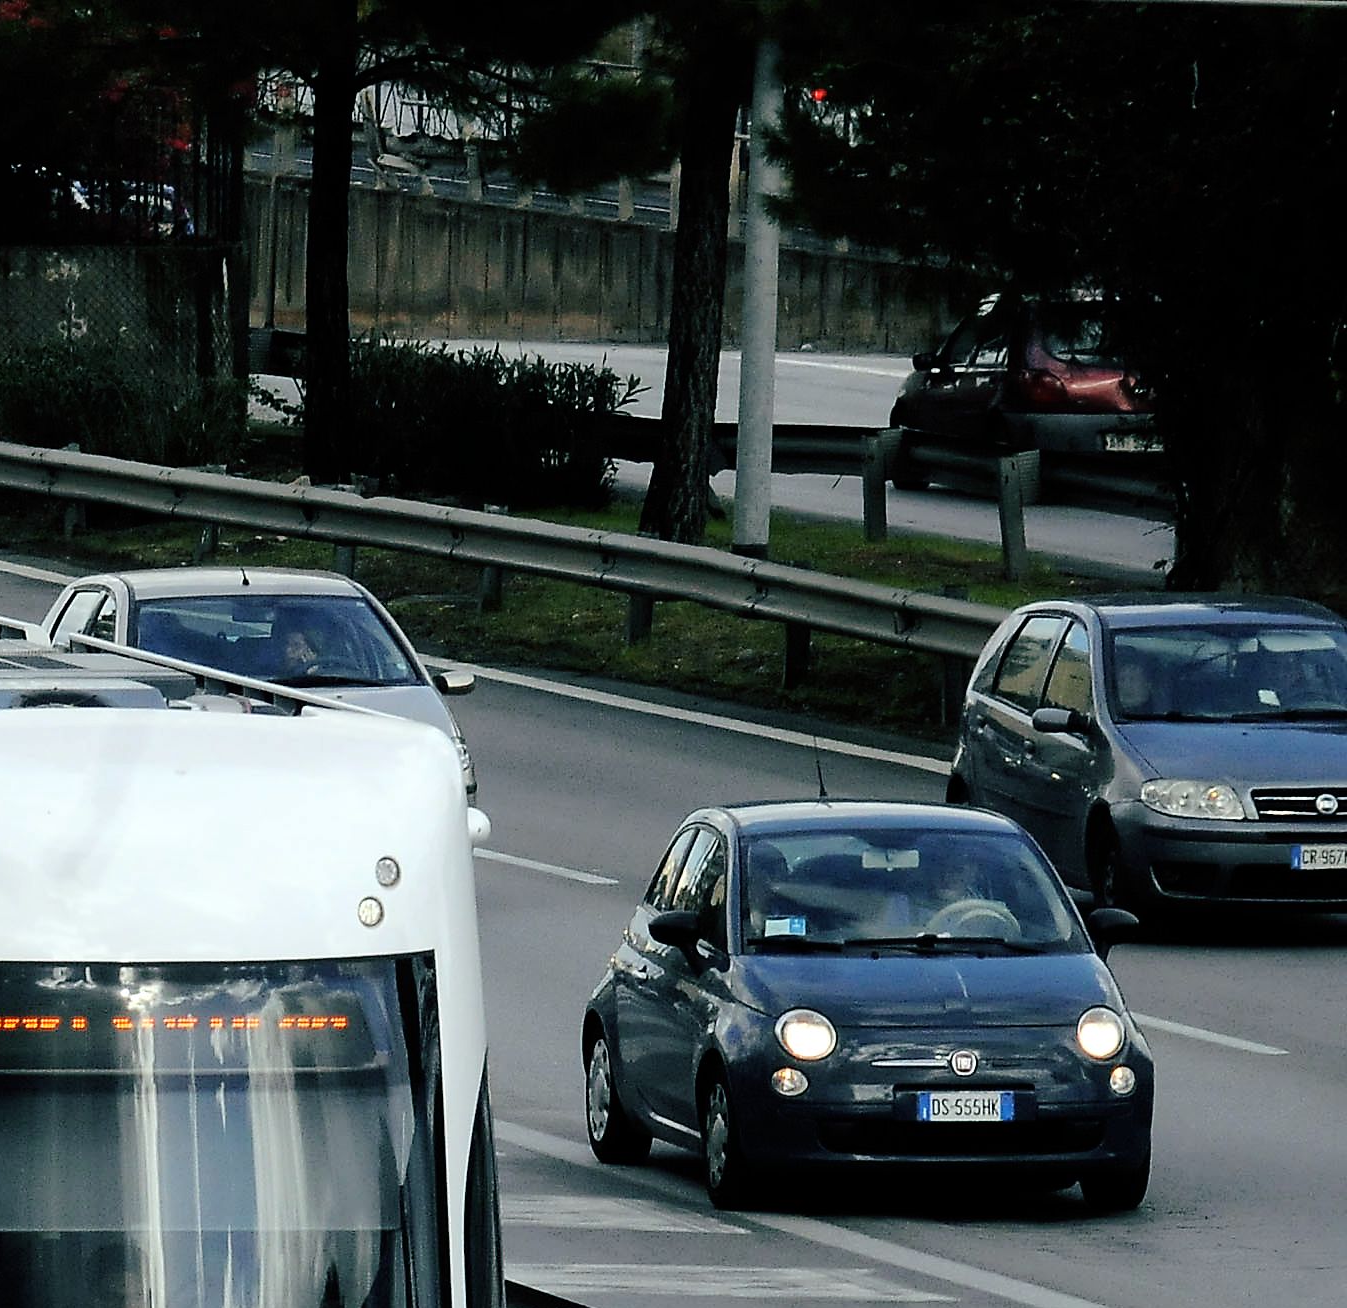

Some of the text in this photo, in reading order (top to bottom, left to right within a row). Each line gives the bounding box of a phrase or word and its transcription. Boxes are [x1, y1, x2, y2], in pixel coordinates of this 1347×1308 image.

[1302, 849, 1317, 865] CR
[932, 1098, 949, 1116] DS
[954, 1098, 999, 1116] 555HK
